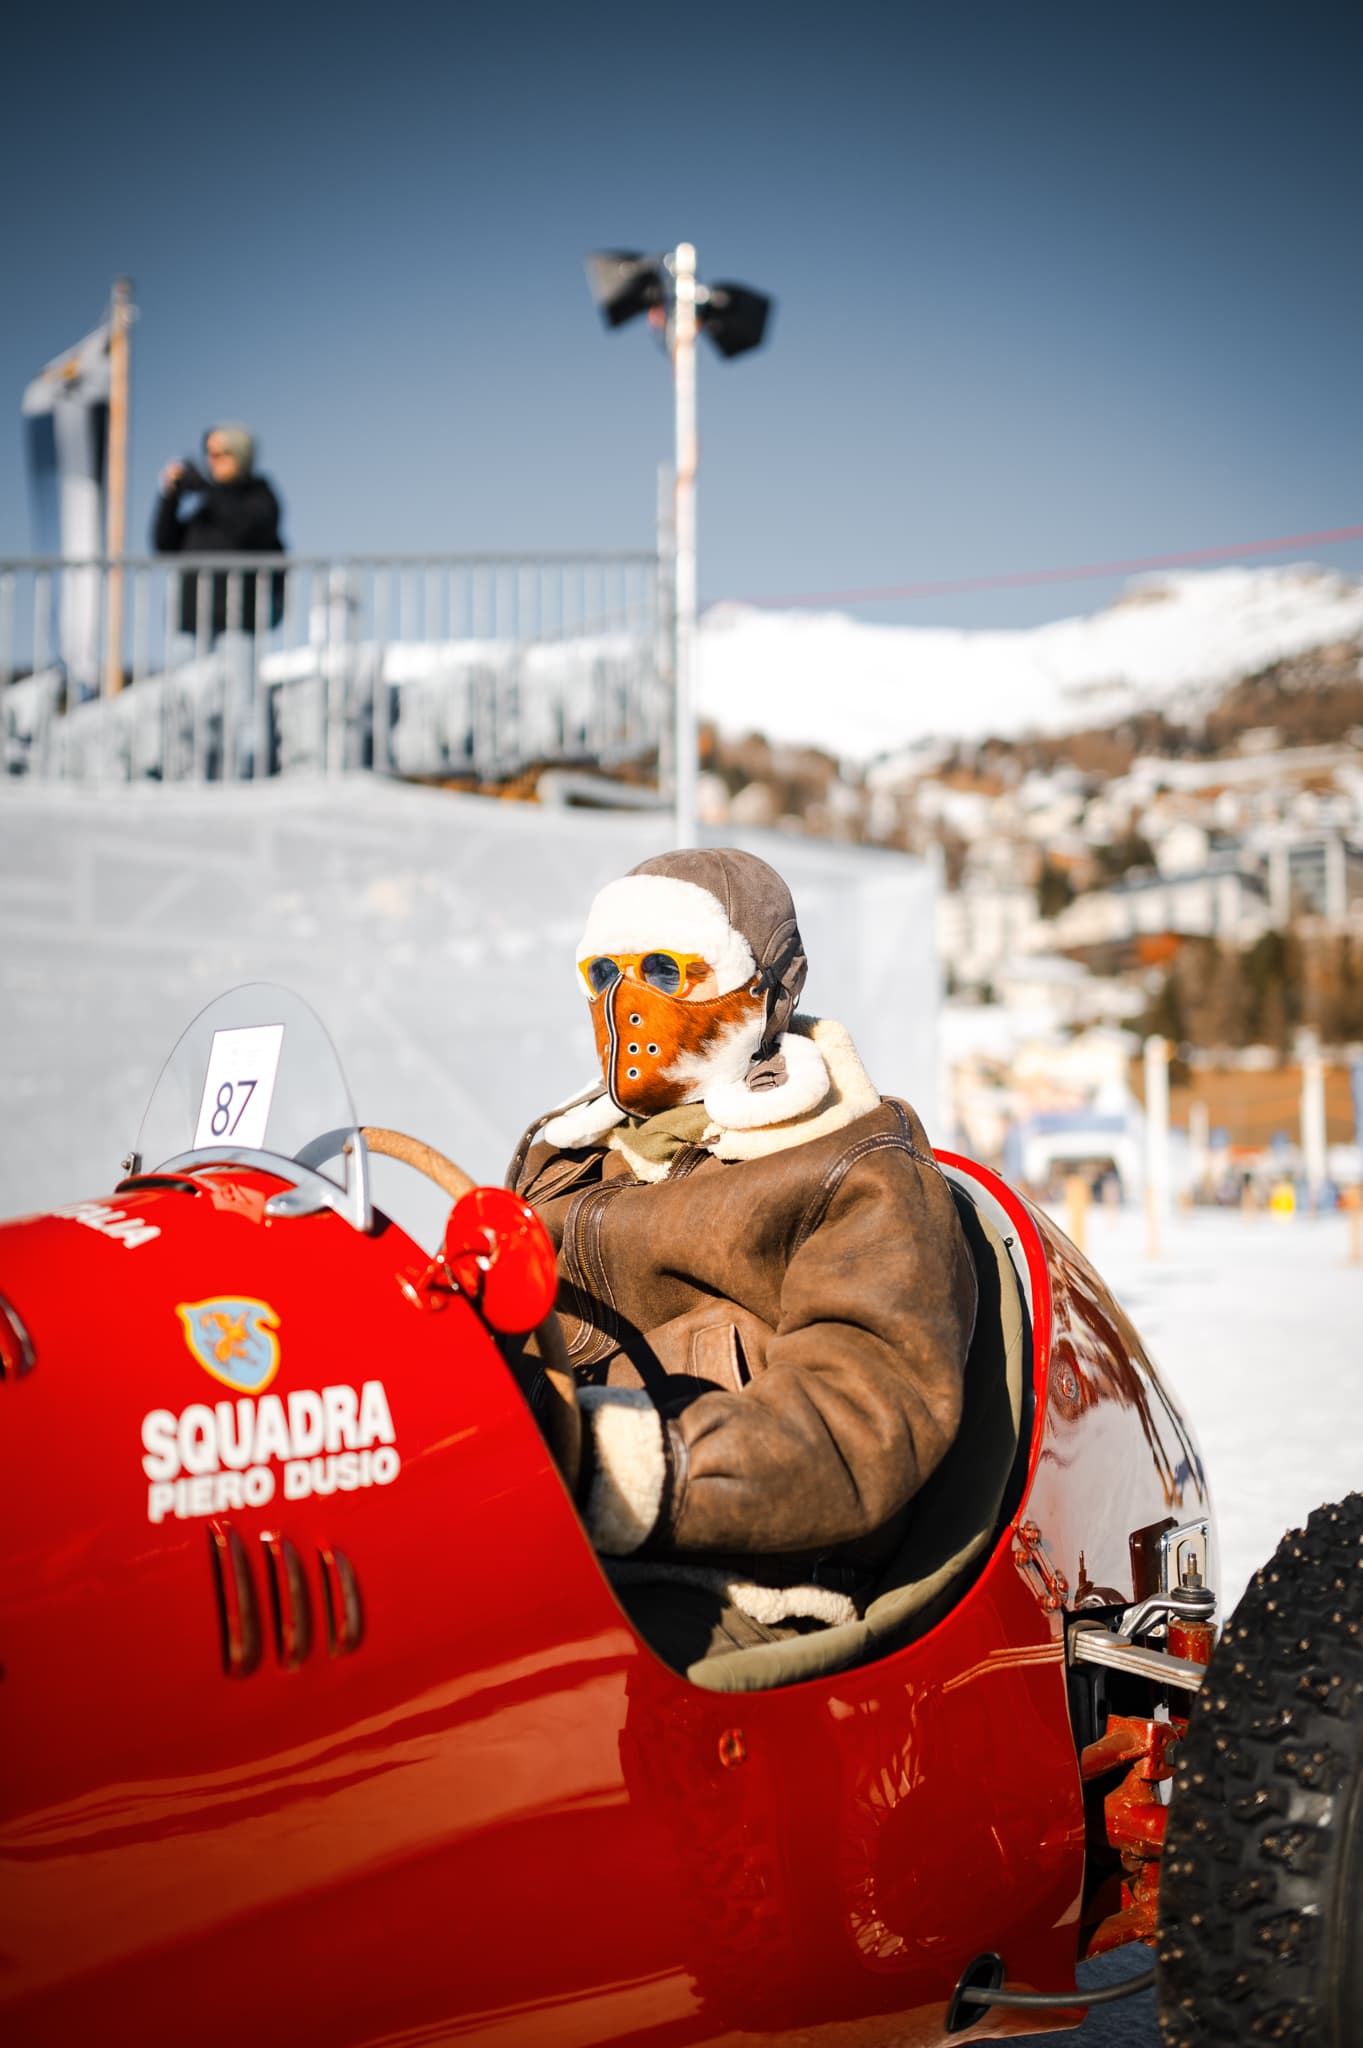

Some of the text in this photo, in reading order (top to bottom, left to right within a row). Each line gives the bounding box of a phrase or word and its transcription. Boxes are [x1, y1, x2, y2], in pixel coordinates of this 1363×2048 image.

[211, 1079, 258, 1137] 87
[141, 1380, 396, 1482] SQUADRA
[147, 1446, 401, 1524] PIERO DUSIO
